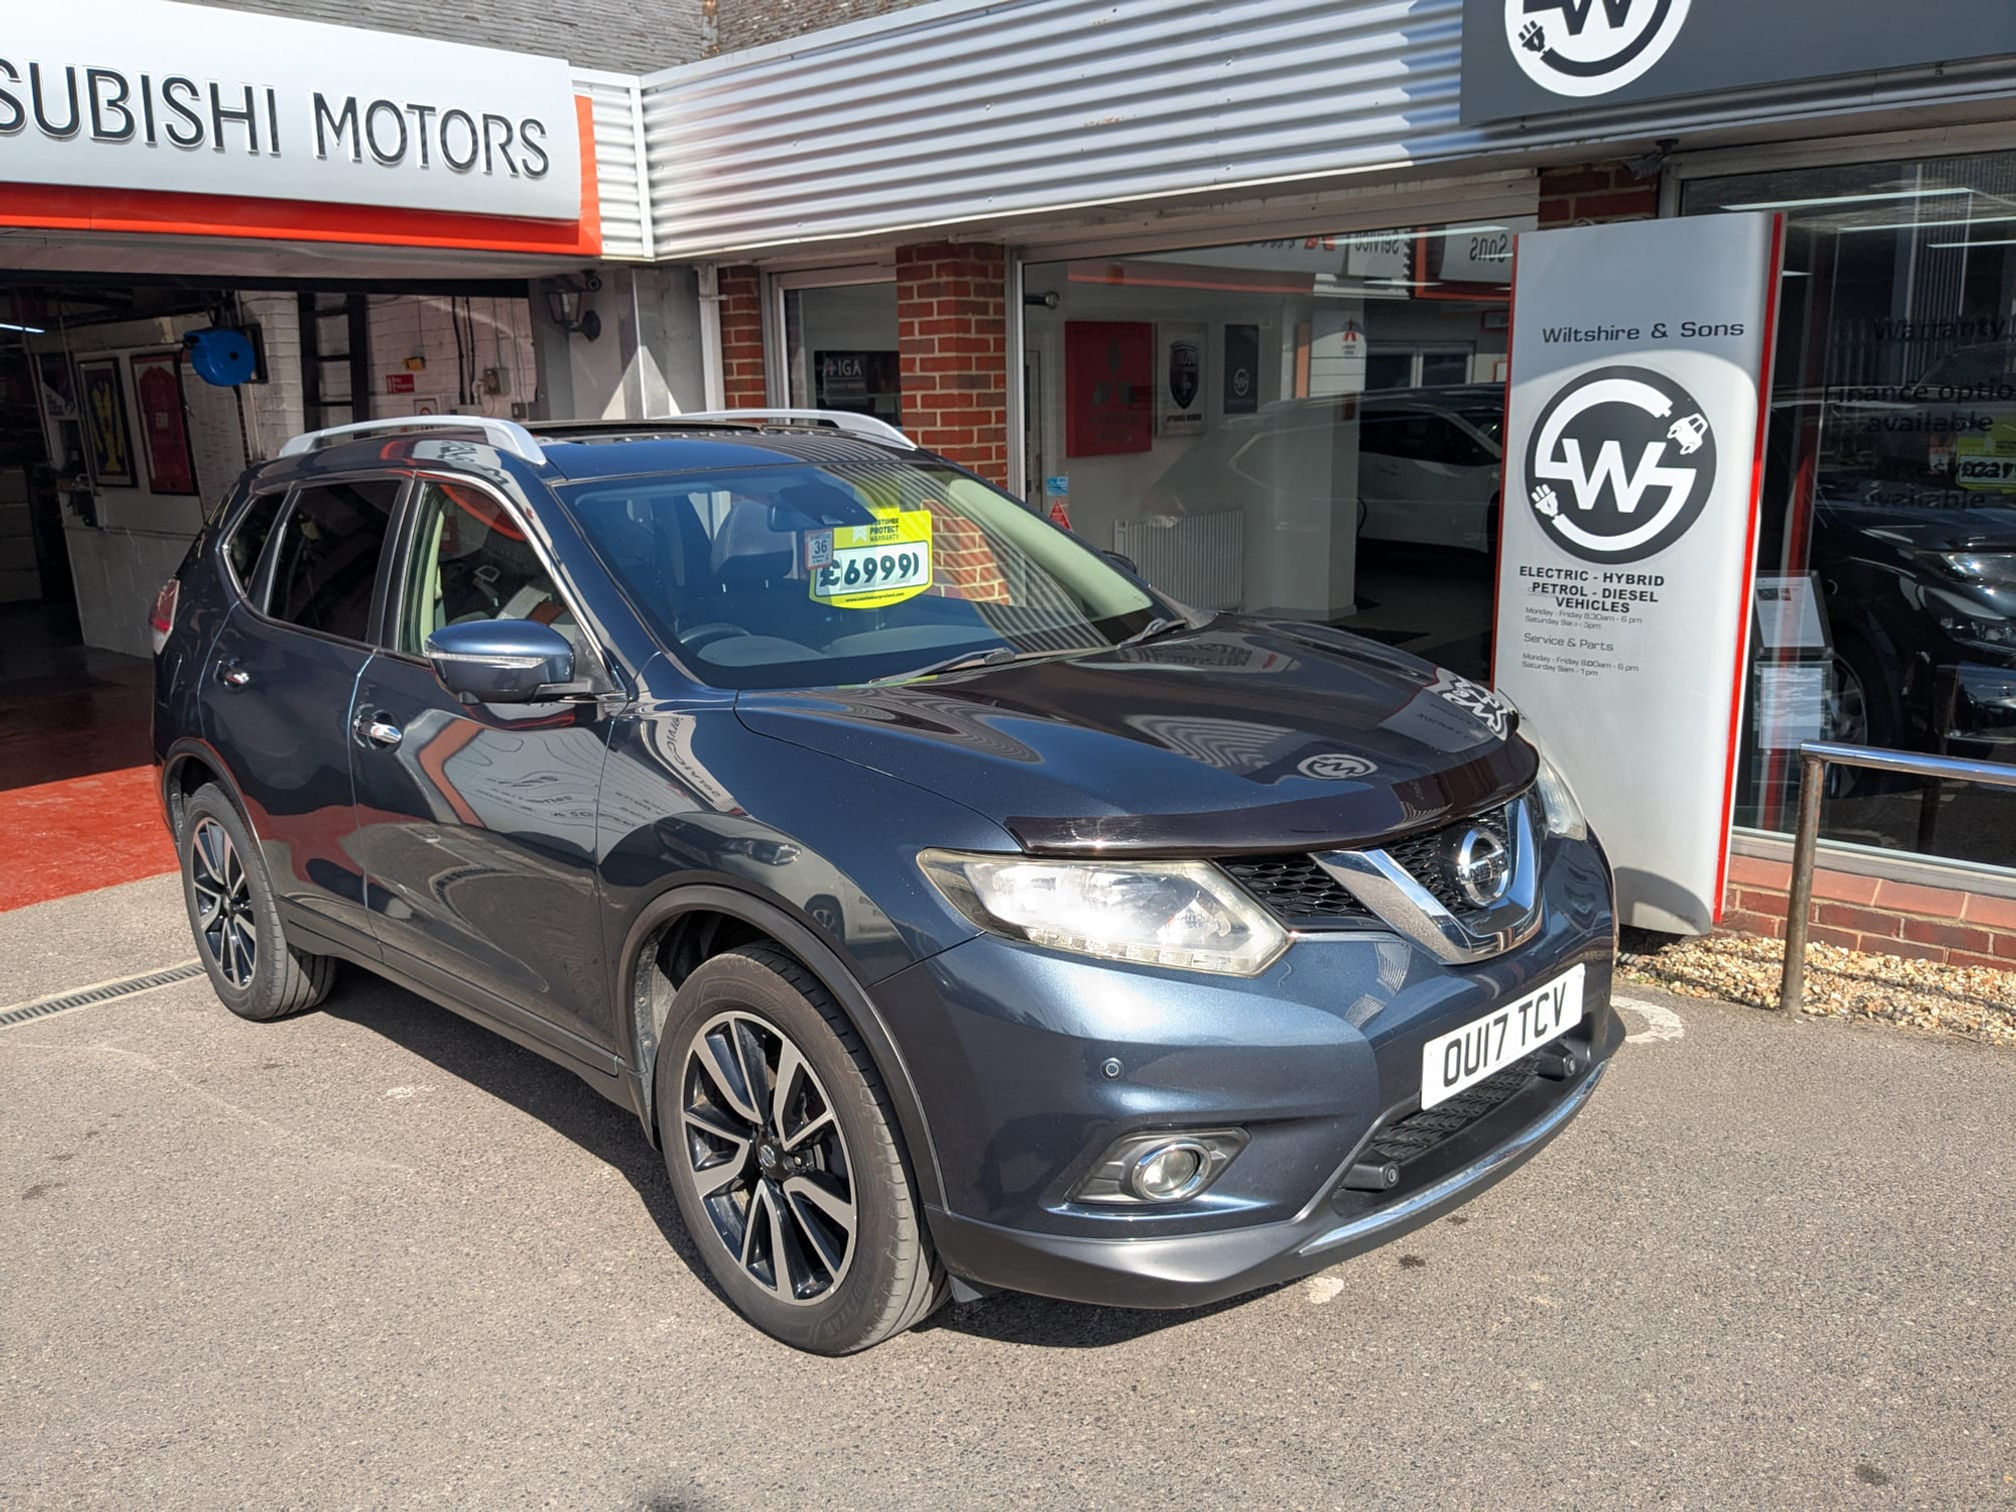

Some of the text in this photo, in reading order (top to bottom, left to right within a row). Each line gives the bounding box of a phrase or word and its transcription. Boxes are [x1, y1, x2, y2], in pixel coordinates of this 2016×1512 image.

[311, 89, 550, 179] MOTORS
[1542, 321, 1745, 343] Wiltshire & Sons
[1866, 411, 1994, 433] available
[814, 540, 827, 554] 36
[1519, 566, 1589, 581] ELECTRIC
[1603, 572, 1665, 586] HYBRID
[1532, 582, 1588, 597] PETROL
[1602, 588, 1659, 602] DIESEL
[1525, 607, 1553, 616] Monday
[1559, 610, 1582, 619] Friday
[1556, 597, 1630, 613] VEHICLES
[1525, 615, 1559, 626] Saturday
[1524, 633, 1614, 652] Service & Parts
[1522, 652, 1551, 663] Monday
[1556, 656, 1580, 666] Friday
[1522, 661, 1556, 672] Saturday
[1443, 982, 1567, 1088] OU17 TCV
